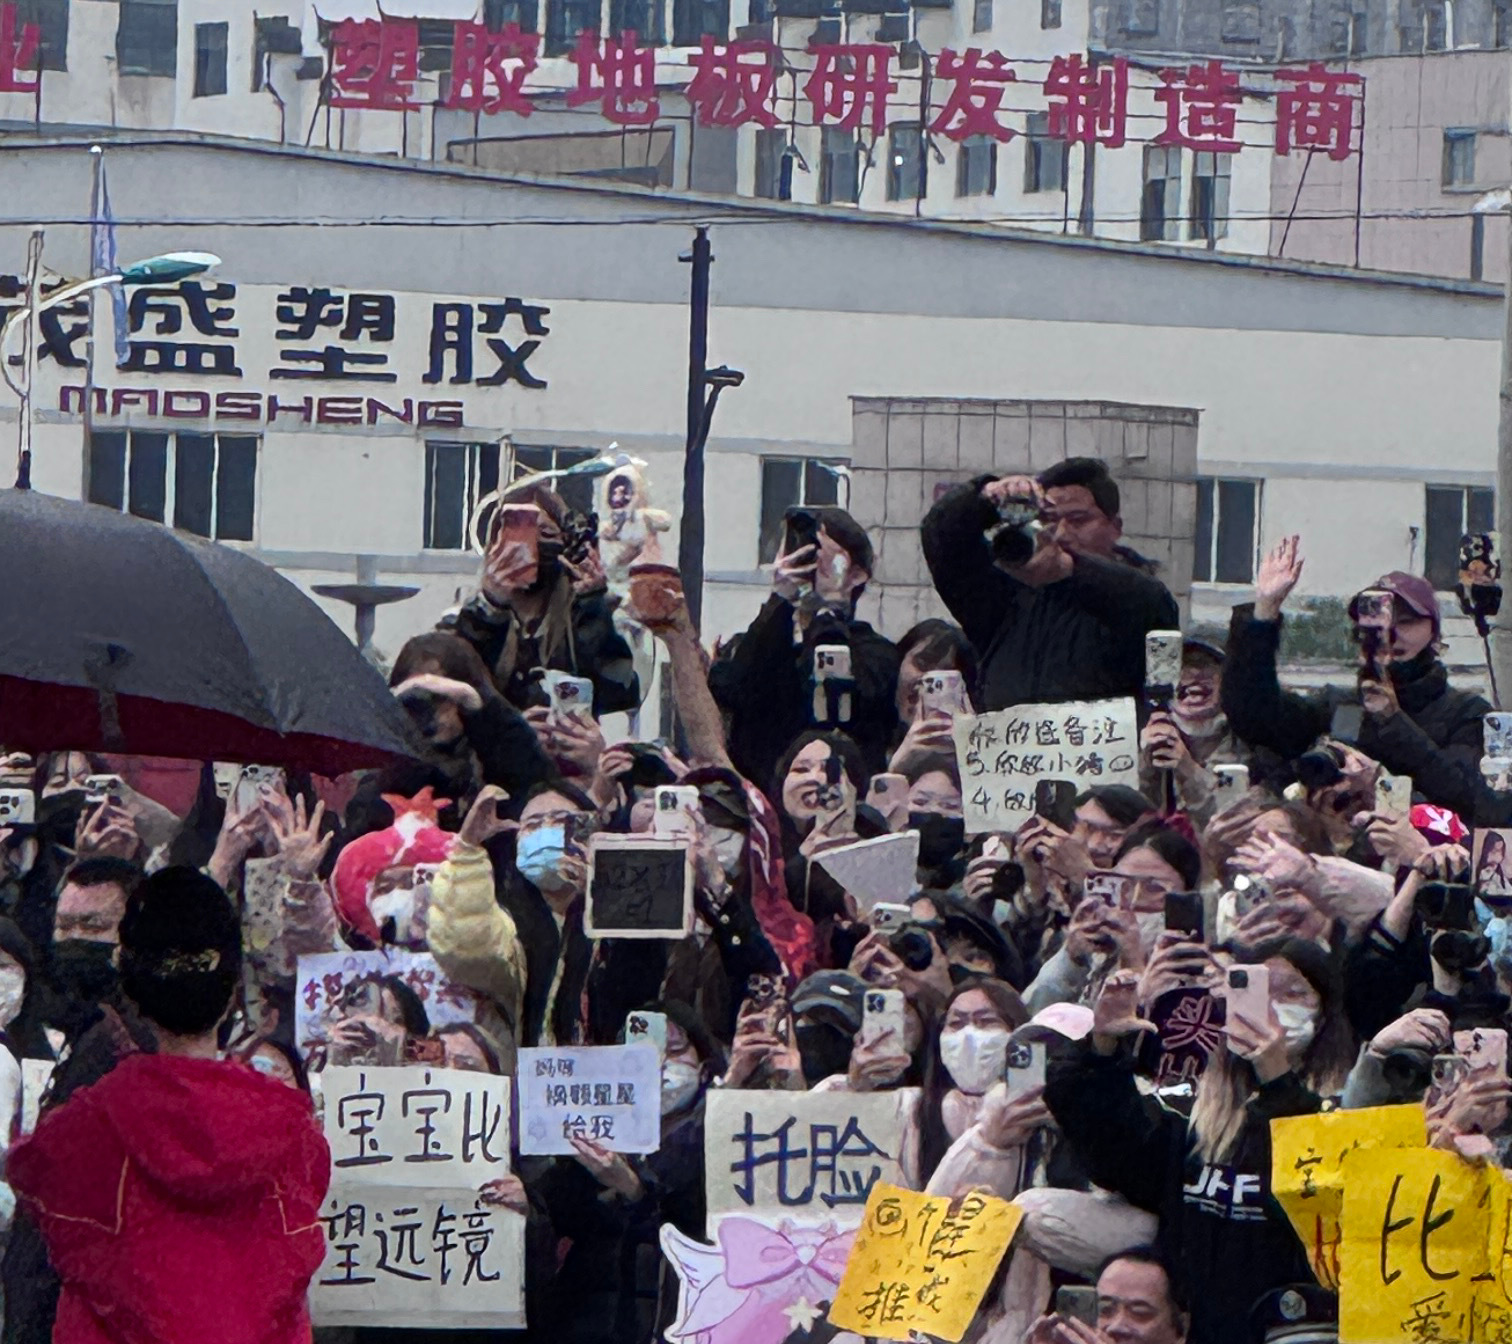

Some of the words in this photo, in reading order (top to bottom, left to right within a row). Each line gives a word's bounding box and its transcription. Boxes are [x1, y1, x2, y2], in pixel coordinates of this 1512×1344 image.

[332, 18, 1364, 161] 塑胶地板研发制造商
[334, 1073, 503, 1167] 宝宝比
[319, 1201, 501, 1286] 望远镜
